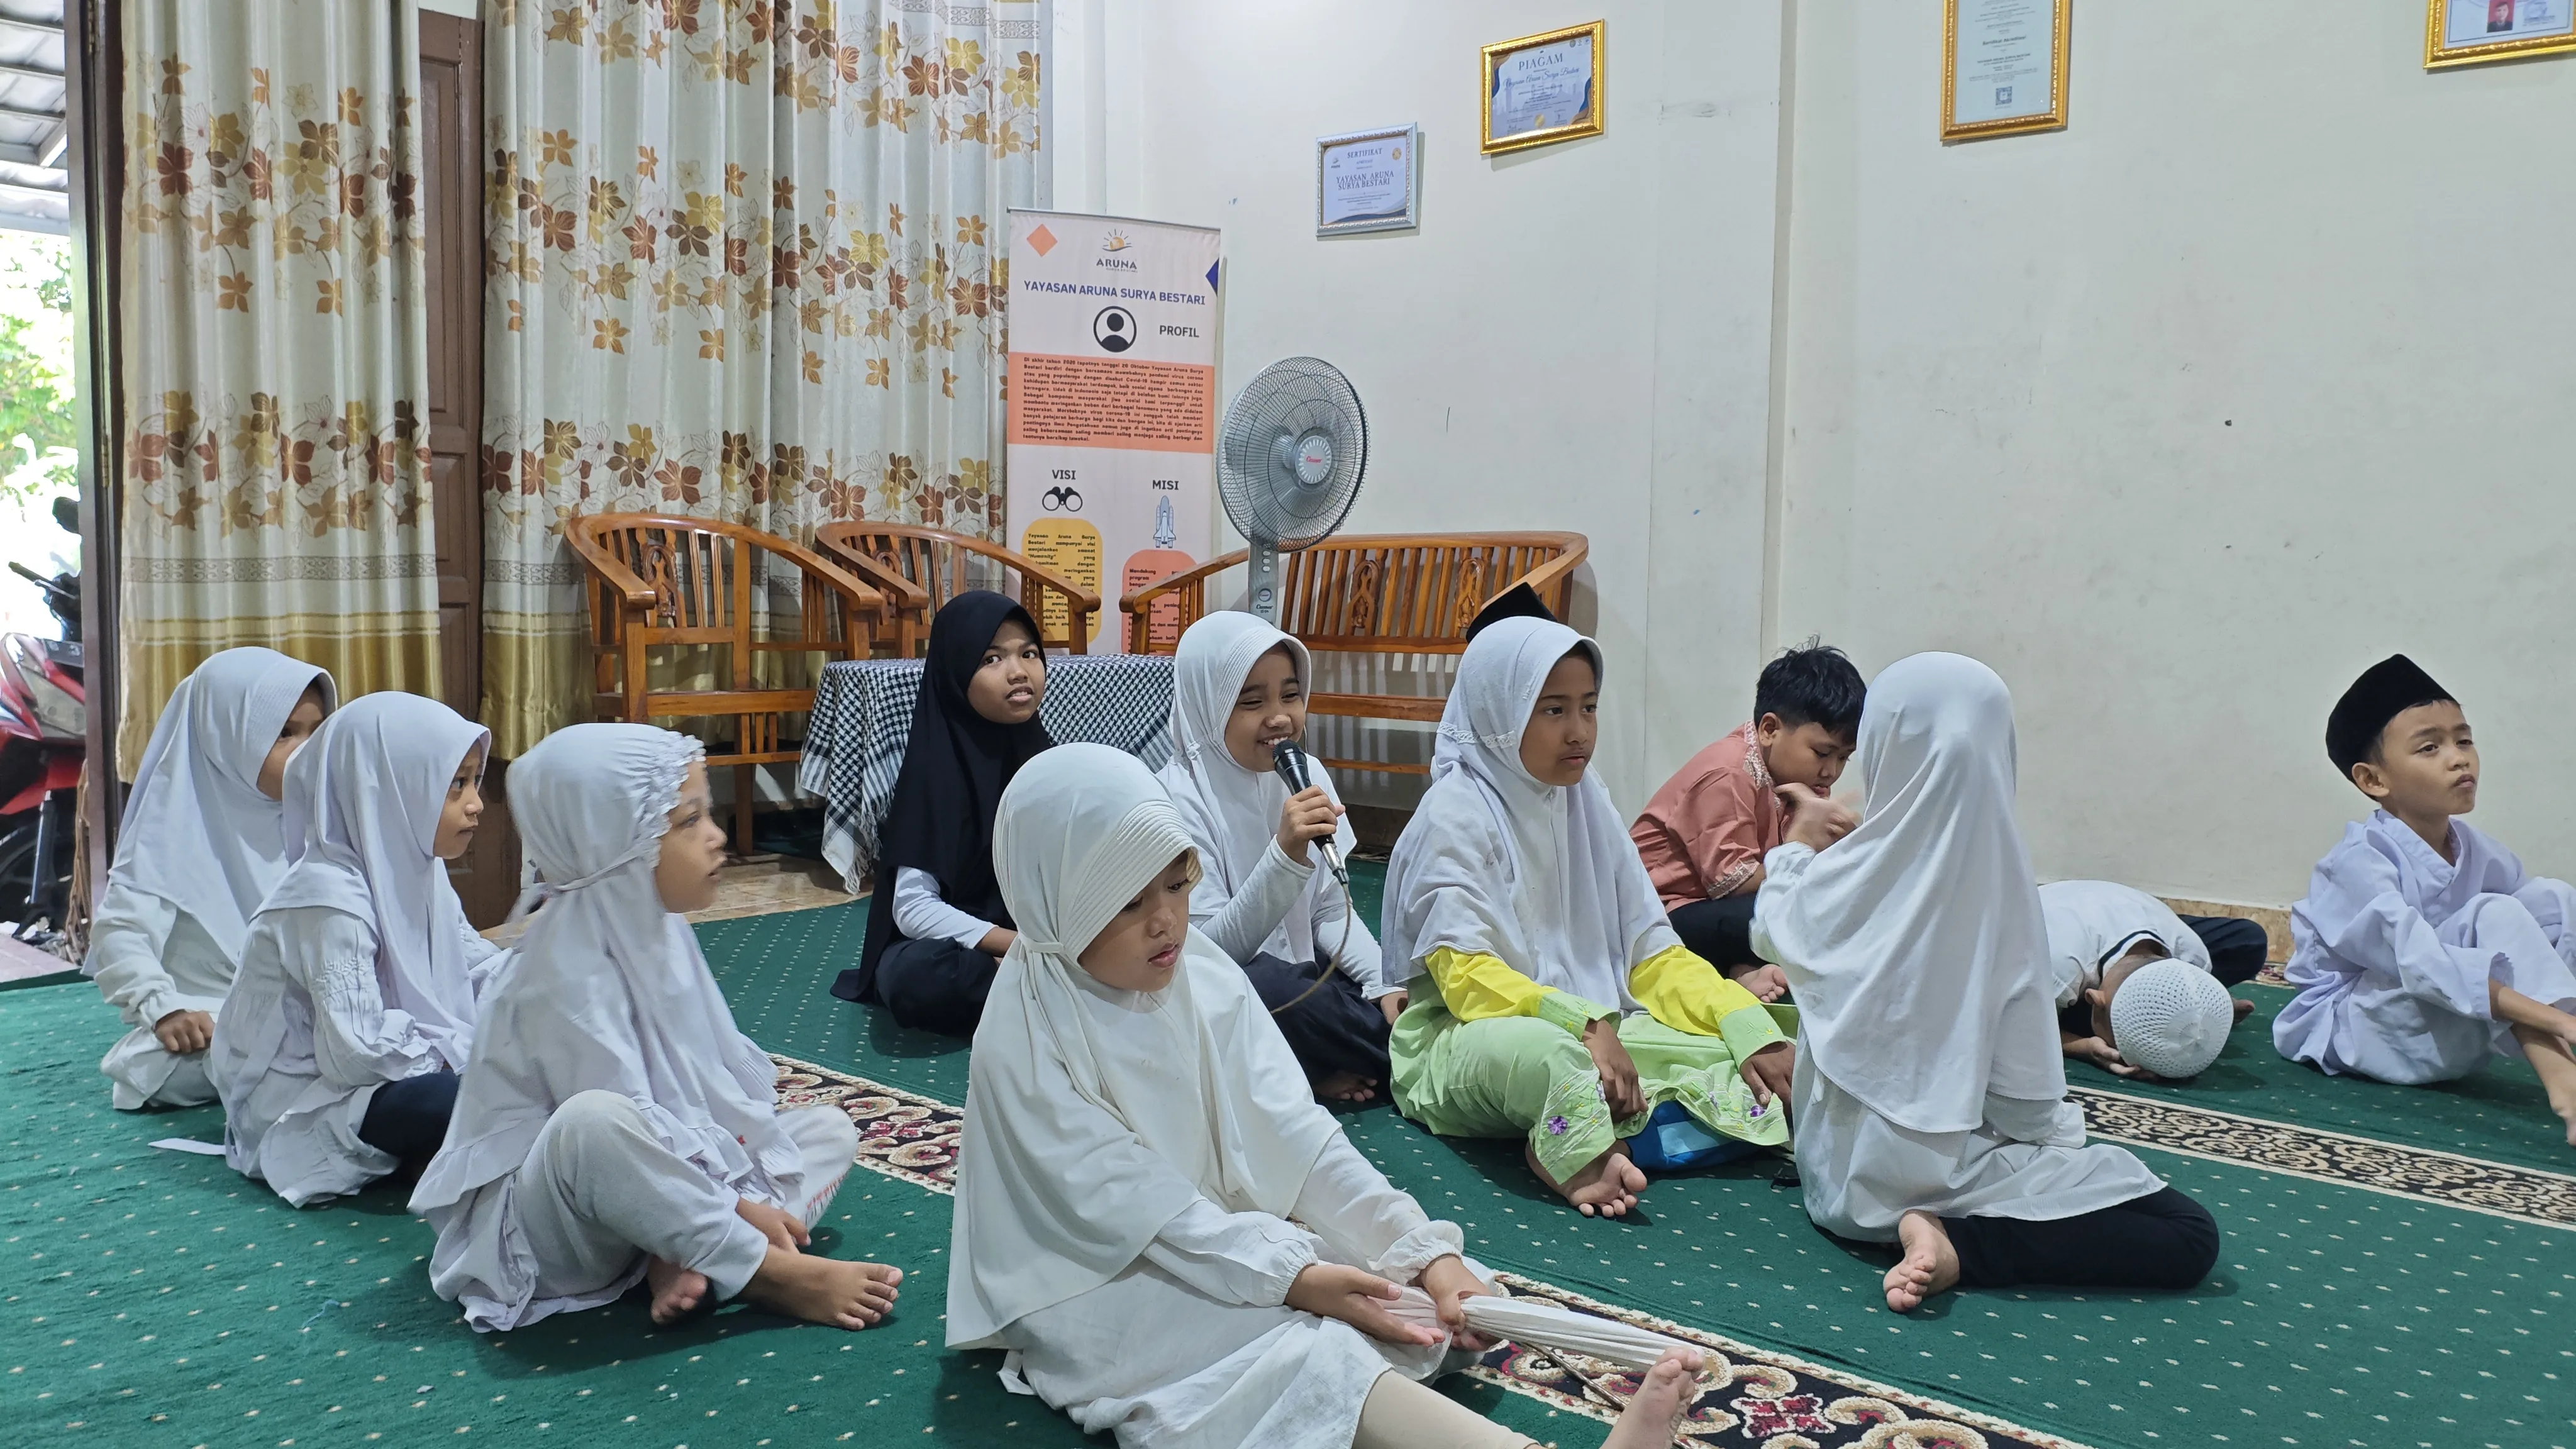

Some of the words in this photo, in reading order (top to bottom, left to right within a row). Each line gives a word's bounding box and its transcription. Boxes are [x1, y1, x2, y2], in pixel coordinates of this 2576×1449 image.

[1519, 53, 1562, 70] PIAGAM
[1347, 148, 1382, 158] SERTIFIKAT
[1336, 173, 1367, 184] YAYASAN
[1370, 170, 1394, 180] ARUNA
[1338, 182, 1360, 191] SURYA
[1362, 178, 1390, 188] BESTARI
[1096, 258, 1138, 270] ARUNA
[1024, 280, 1076, 294] YAYASAN
[1079, 286, 1118, 297] ARUNA
[1121, 289, 1157, 301] SURYA
[1159, 292, 1206, 306] BESTARI
[1160, 325, 1199, 338] PROFIL
[1052, 470, 1076, 480] VISI
[1152, 480, 1179, 491] MISI
